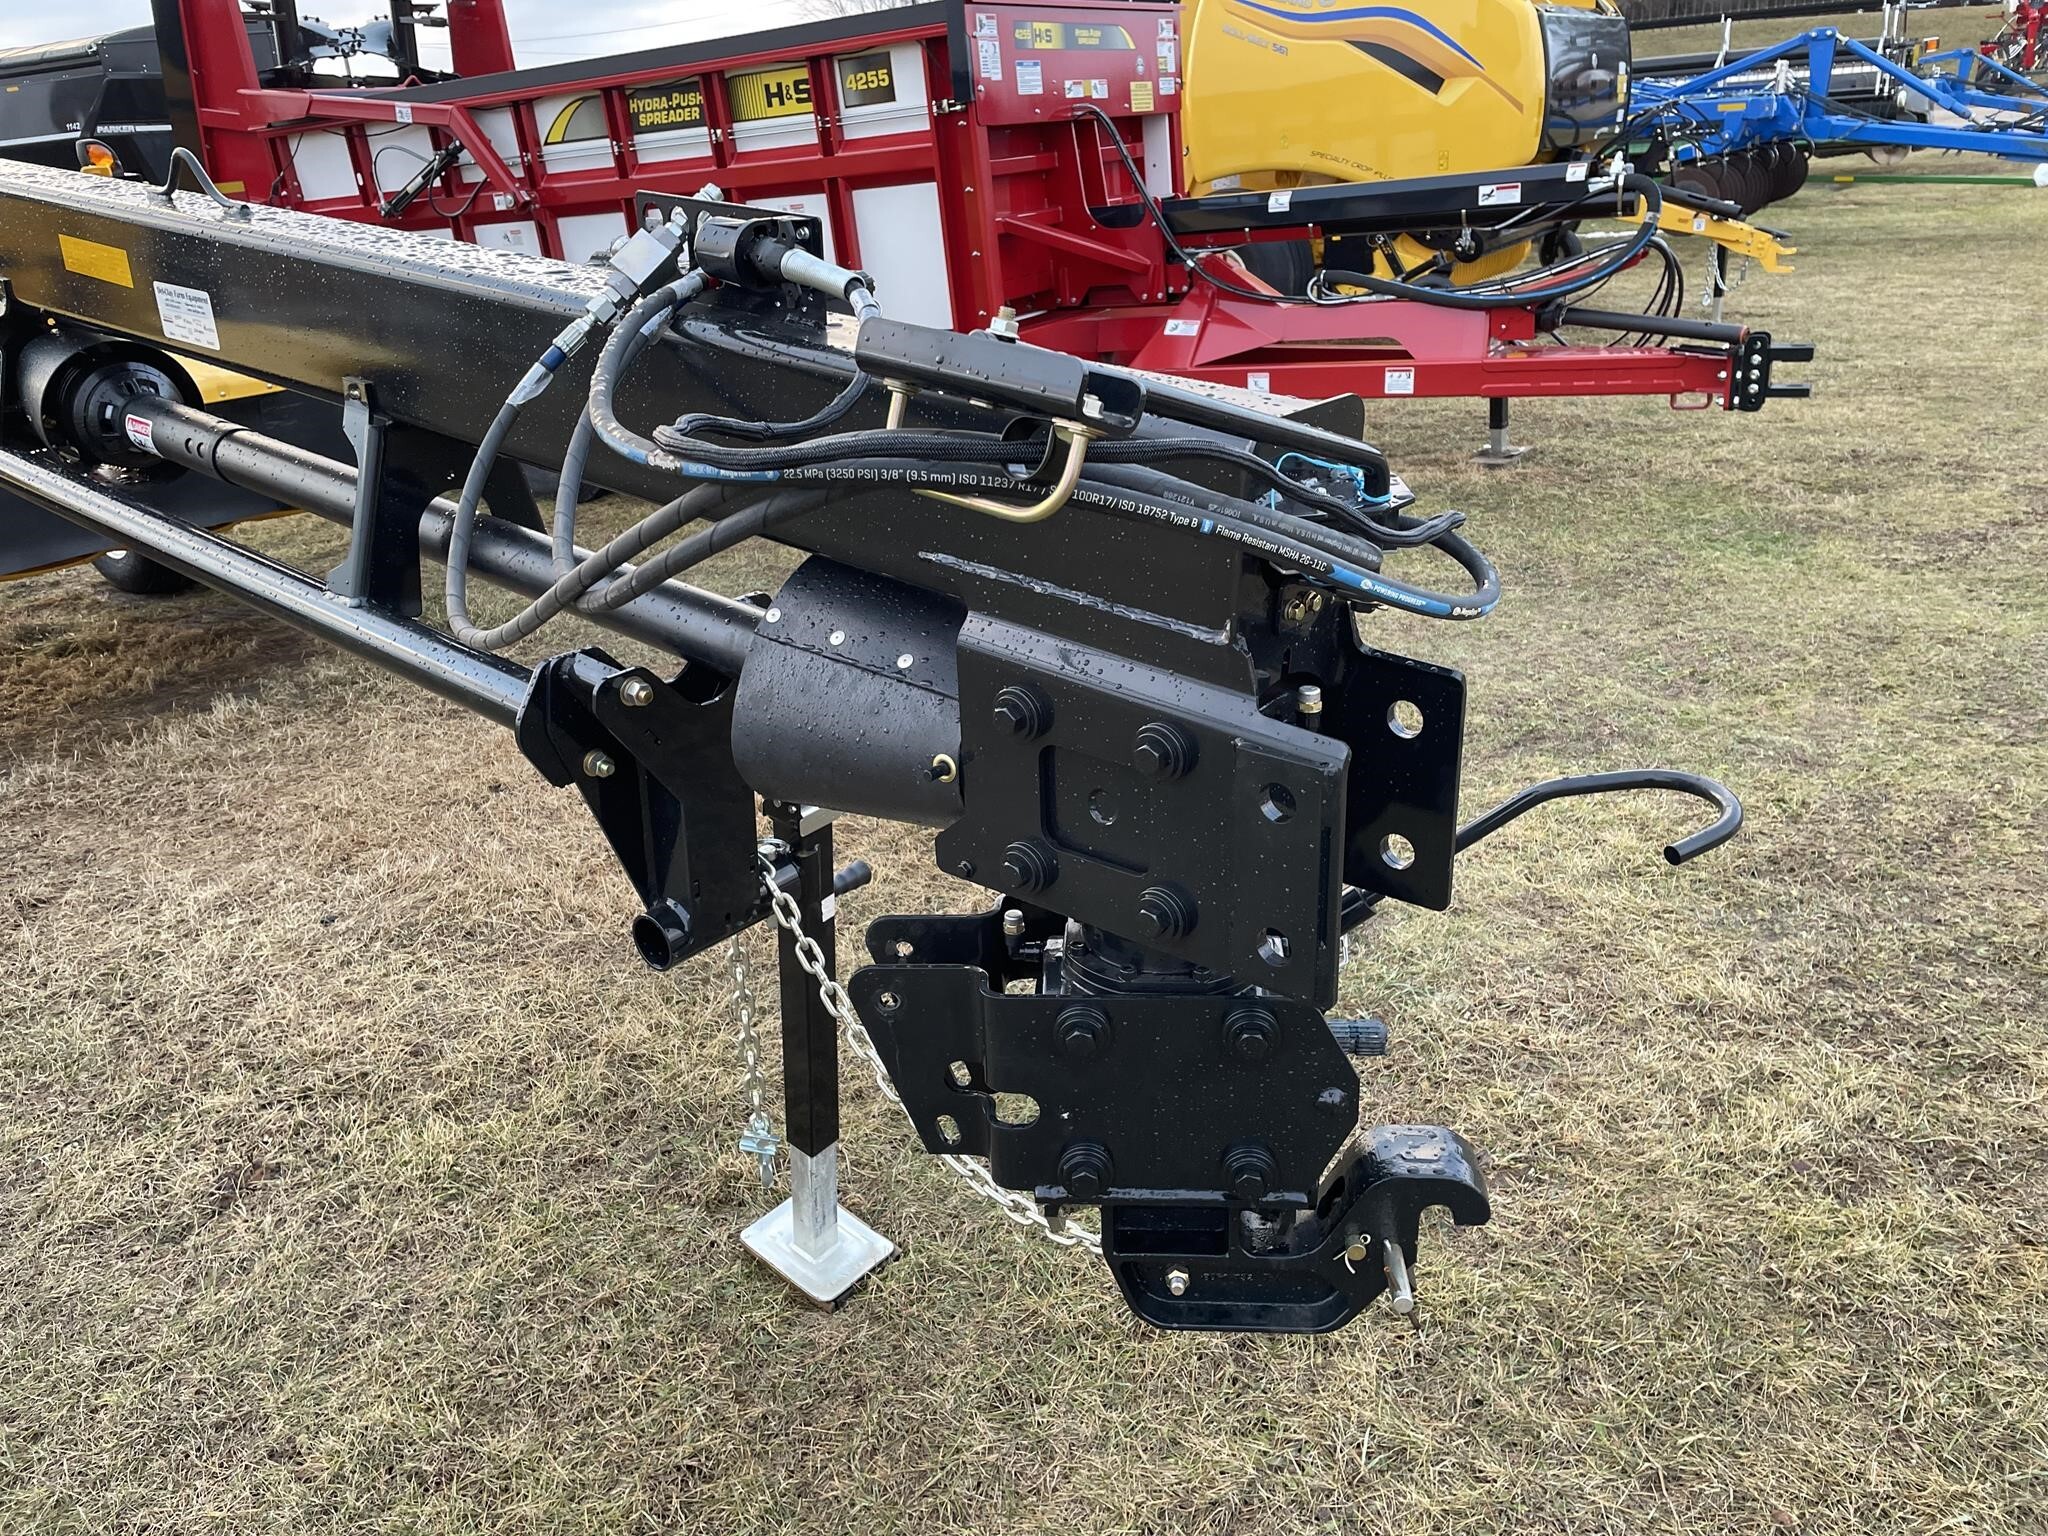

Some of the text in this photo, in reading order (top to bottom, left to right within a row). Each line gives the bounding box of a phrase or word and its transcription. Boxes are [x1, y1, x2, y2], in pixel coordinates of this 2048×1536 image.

[845, 68, 889, 92] 4255
[66, 122, 80, 130] 1142
[638, 107, 700, 127] SPREADER
[96, 124, 136, 134] PARKER
[783, 468, 802, 479] 22.5
[804, 468, 824, 479] MPa
[826, 468, 854, 480] (3250
[857, 468, 878, 482] PSI)
[906, 470, 928, 482] (9.5
[930, 472, 956, 486] mm)
[959, 474, 977, 486] ISO
[980, 475, 1015, 489] 11237
[1118, 499, 1136, 512] ISO
[1136, 504, 1168, 520] 18752
[1169, 512, 1190, 526] Type
[1190, 518, 1198, 528] B
[1216, 524, 1242, 541] Flame
[1242, 533, 1279, 553] Resistant
[1278, 546, 1300, 562] MSHA
[1300, 554, 1327, 572] 2G-11C
